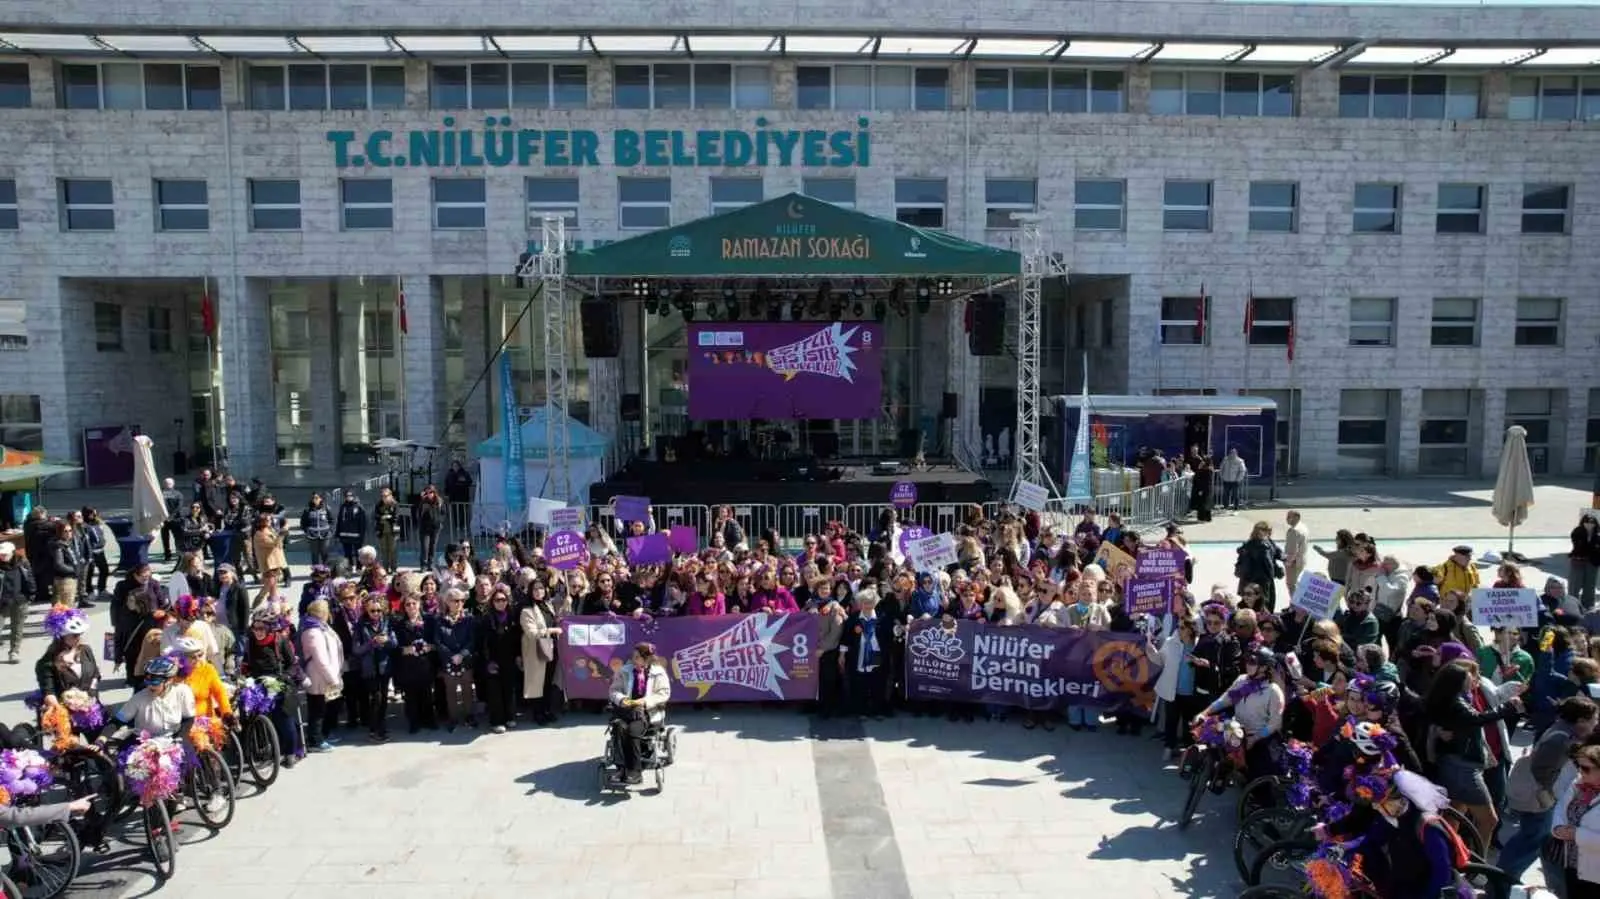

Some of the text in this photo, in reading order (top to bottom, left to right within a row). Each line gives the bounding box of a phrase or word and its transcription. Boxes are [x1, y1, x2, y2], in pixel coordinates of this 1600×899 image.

[614, 117, 870, 168] BELEDİYESİ
[721, 233, 870, 259] RAMAZAN SOKAĞI
[862, 330, 872, 343] 8
[556, 534, 570, 546] C2
[792, 633, 809, 658] 8
[973, 634, 1055, 660] Nilüfer
[971, 655, 1041, 679] Kadın
[971, 674, 1101, 698] Dernekleri
